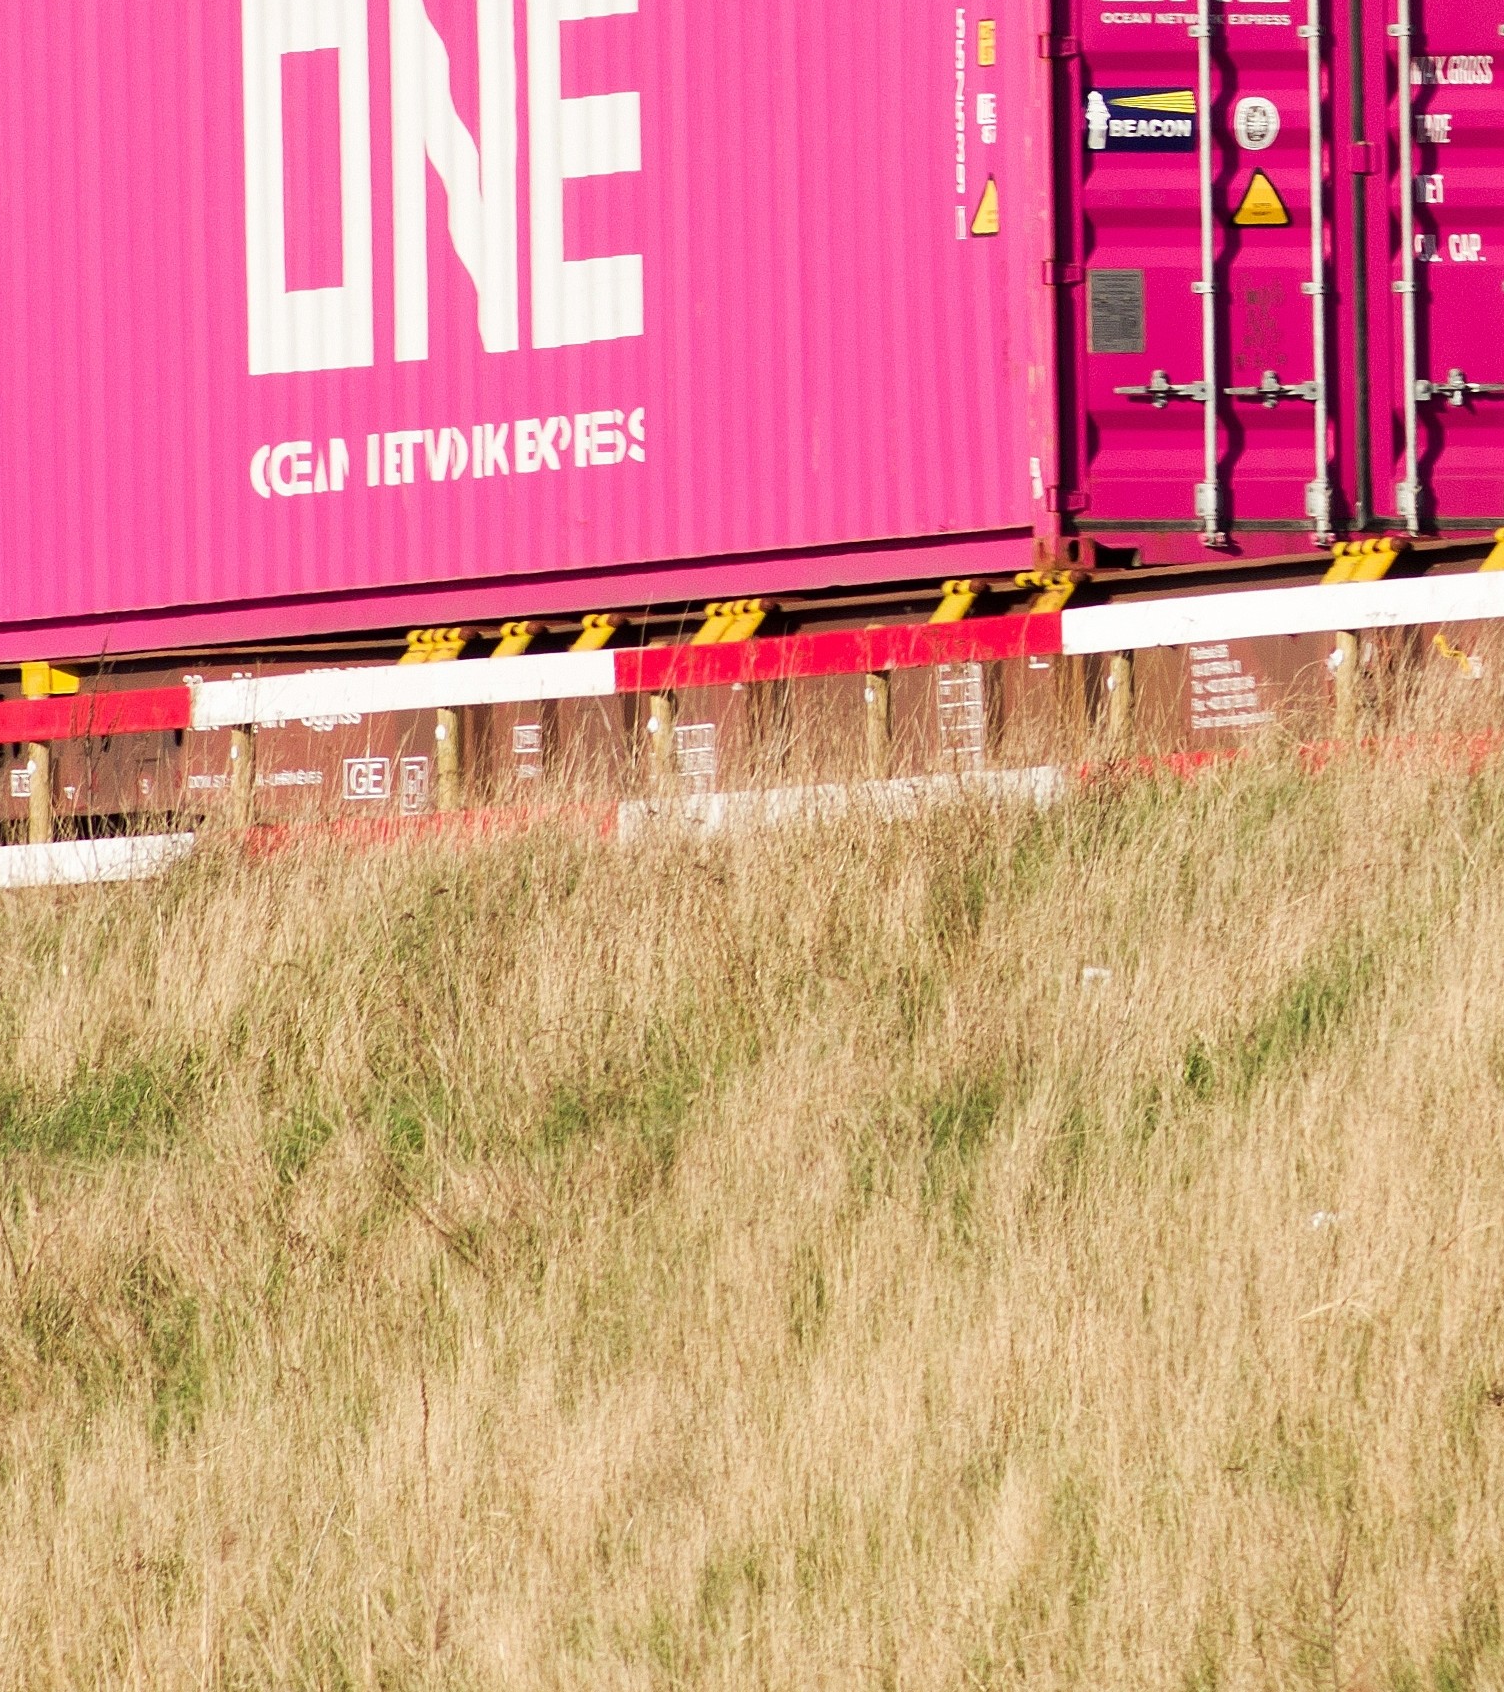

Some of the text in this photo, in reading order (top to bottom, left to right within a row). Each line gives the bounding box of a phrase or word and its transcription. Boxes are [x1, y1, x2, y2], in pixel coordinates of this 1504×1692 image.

[1100, 12, 1293, 27] OCEAN NETWRK EXPRESS
[1108, 118, 1193, 138] BEACON
[348, 762, 385, 796] GE
